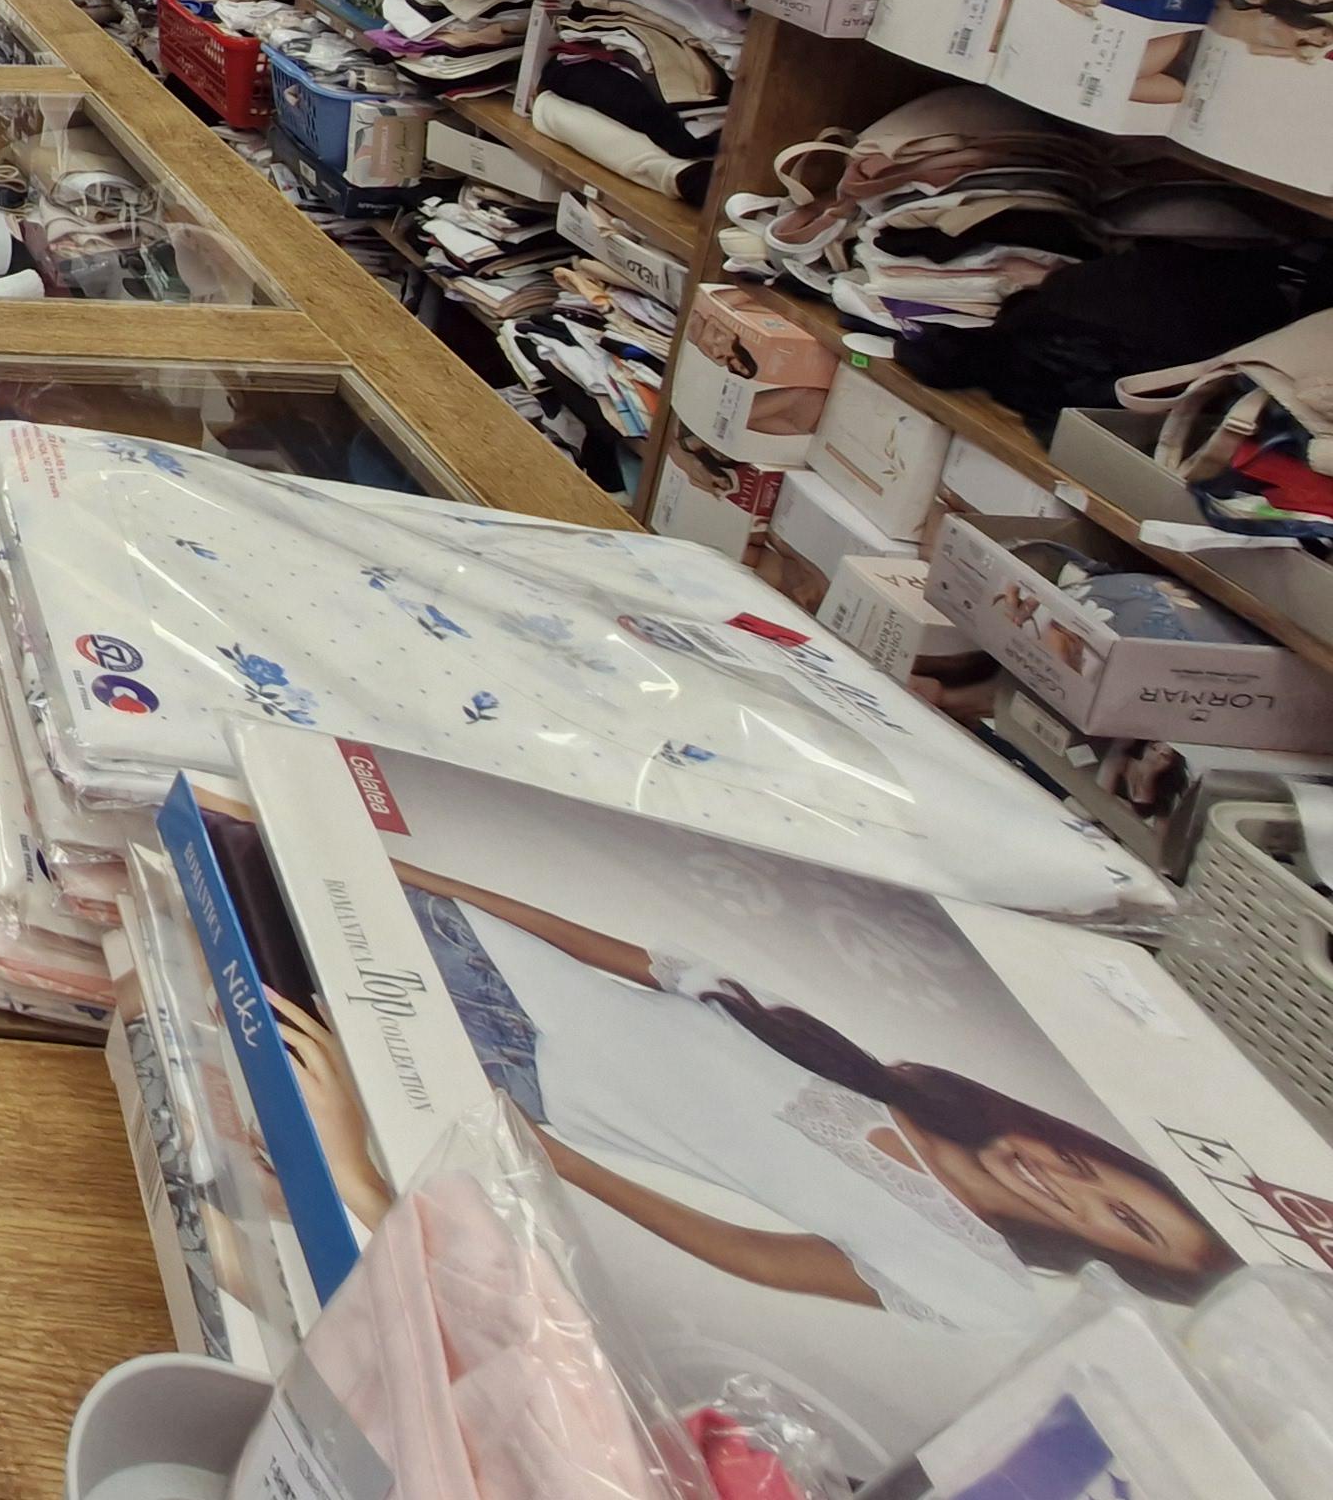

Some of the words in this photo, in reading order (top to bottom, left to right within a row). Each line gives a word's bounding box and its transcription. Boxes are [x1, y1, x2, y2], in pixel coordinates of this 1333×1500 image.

[1139, 687, 1275, 710] LORMAR
[348, 753, 389, 816] Galatea
[221, 958, 260, 1049] Niki
[345, 966, 428, 1020] Top
[376, 1013, 435, 1114] COLLECTION
